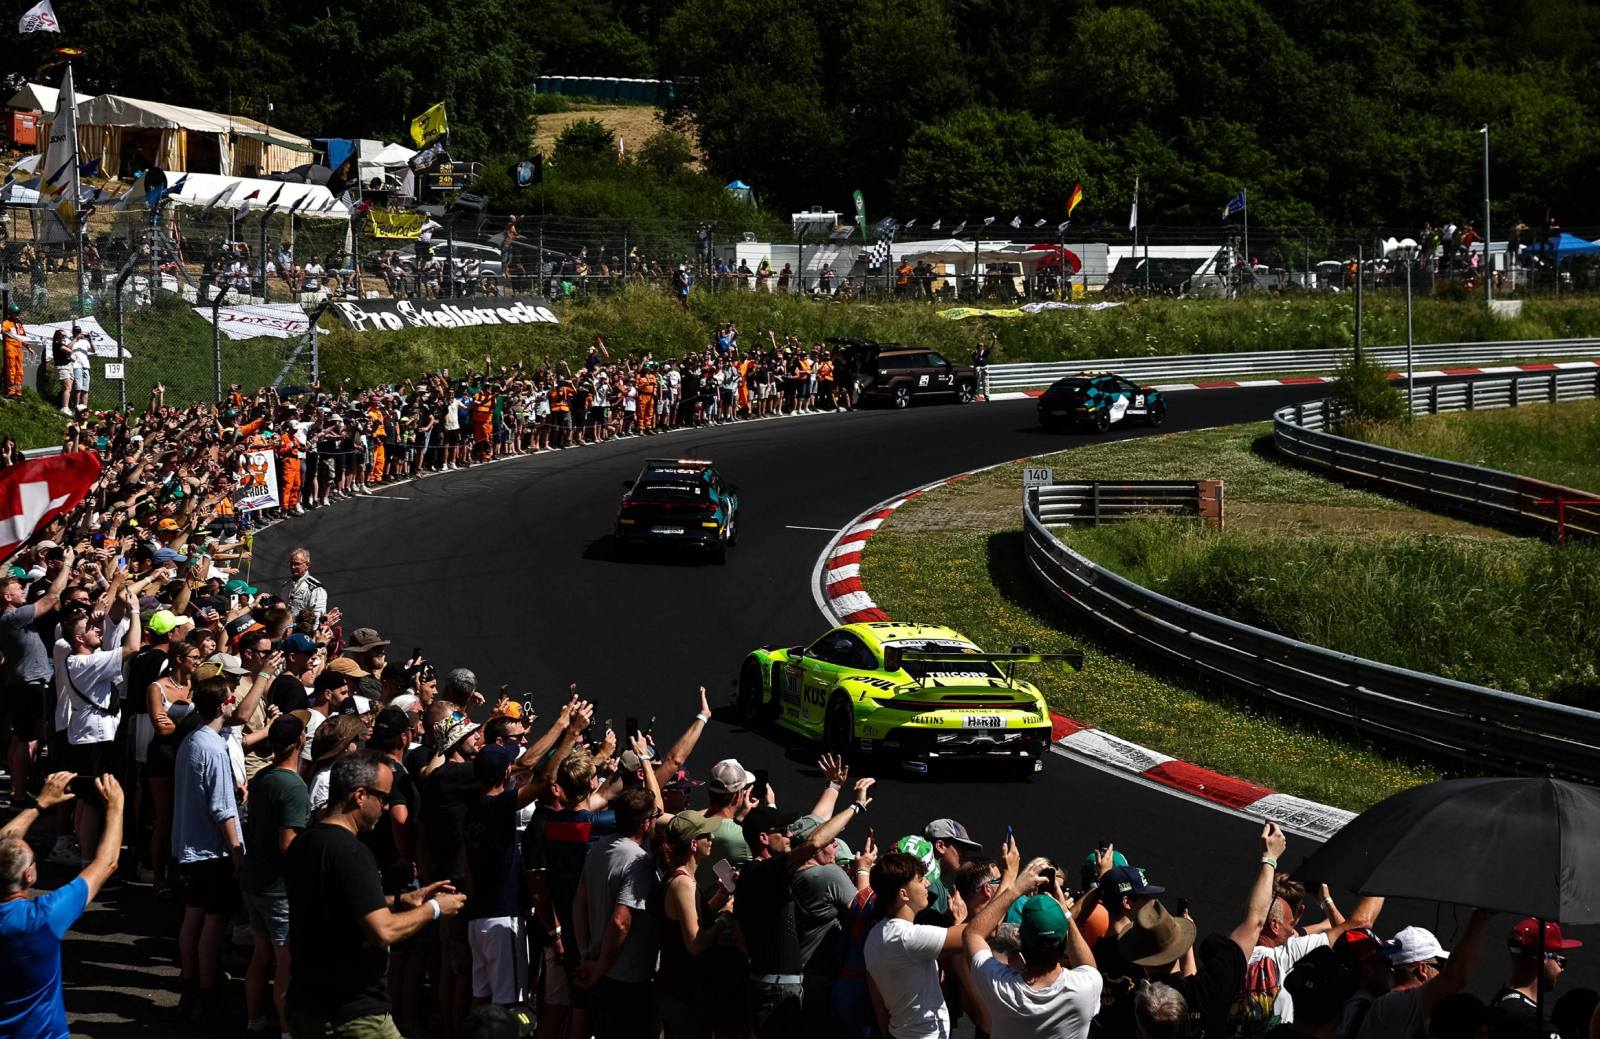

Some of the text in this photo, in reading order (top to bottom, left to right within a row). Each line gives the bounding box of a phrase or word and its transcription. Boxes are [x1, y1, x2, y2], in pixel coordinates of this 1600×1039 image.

[335, 302, 404, 332] Pro
[108, 364, 121, 374] 139
[948, 374, 954, 386] 2
[1028, 469, 1048, 481] 140
[926, 671, 989, 679] TRICORP
[910, 716, 944, 725] VELTINS
